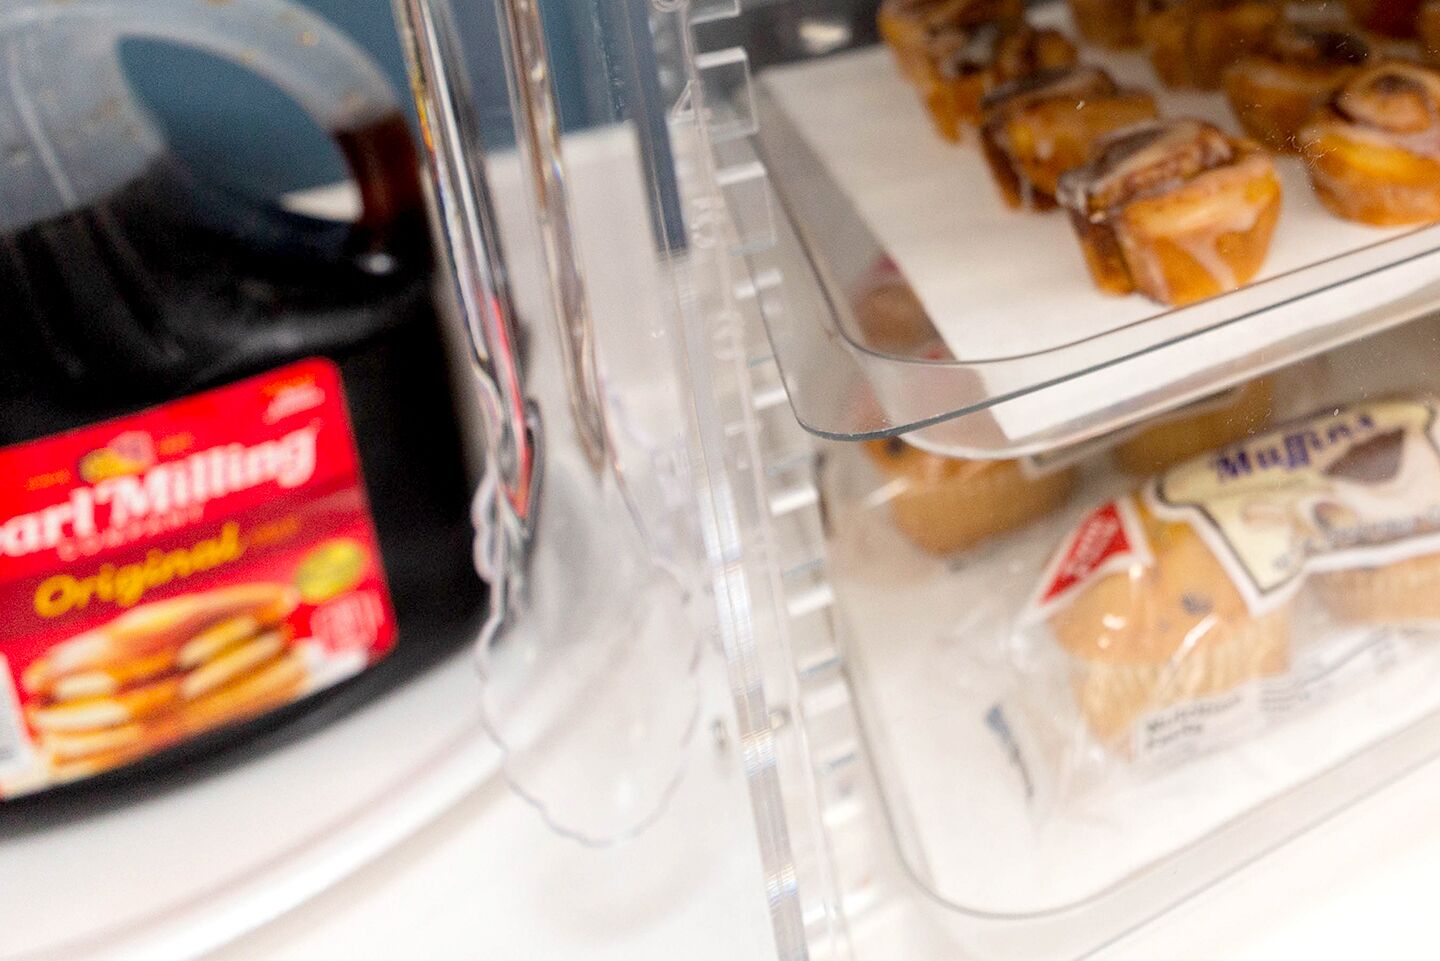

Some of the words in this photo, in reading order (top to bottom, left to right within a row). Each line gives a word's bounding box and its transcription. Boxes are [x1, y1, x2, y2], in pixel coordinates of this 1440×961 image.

[0, 486, 96, 557] arl
[94, 419, 321, 524] Milling
[1209, 414, 1374, 480] Muffins
[34, 522, 240, 617] Original
